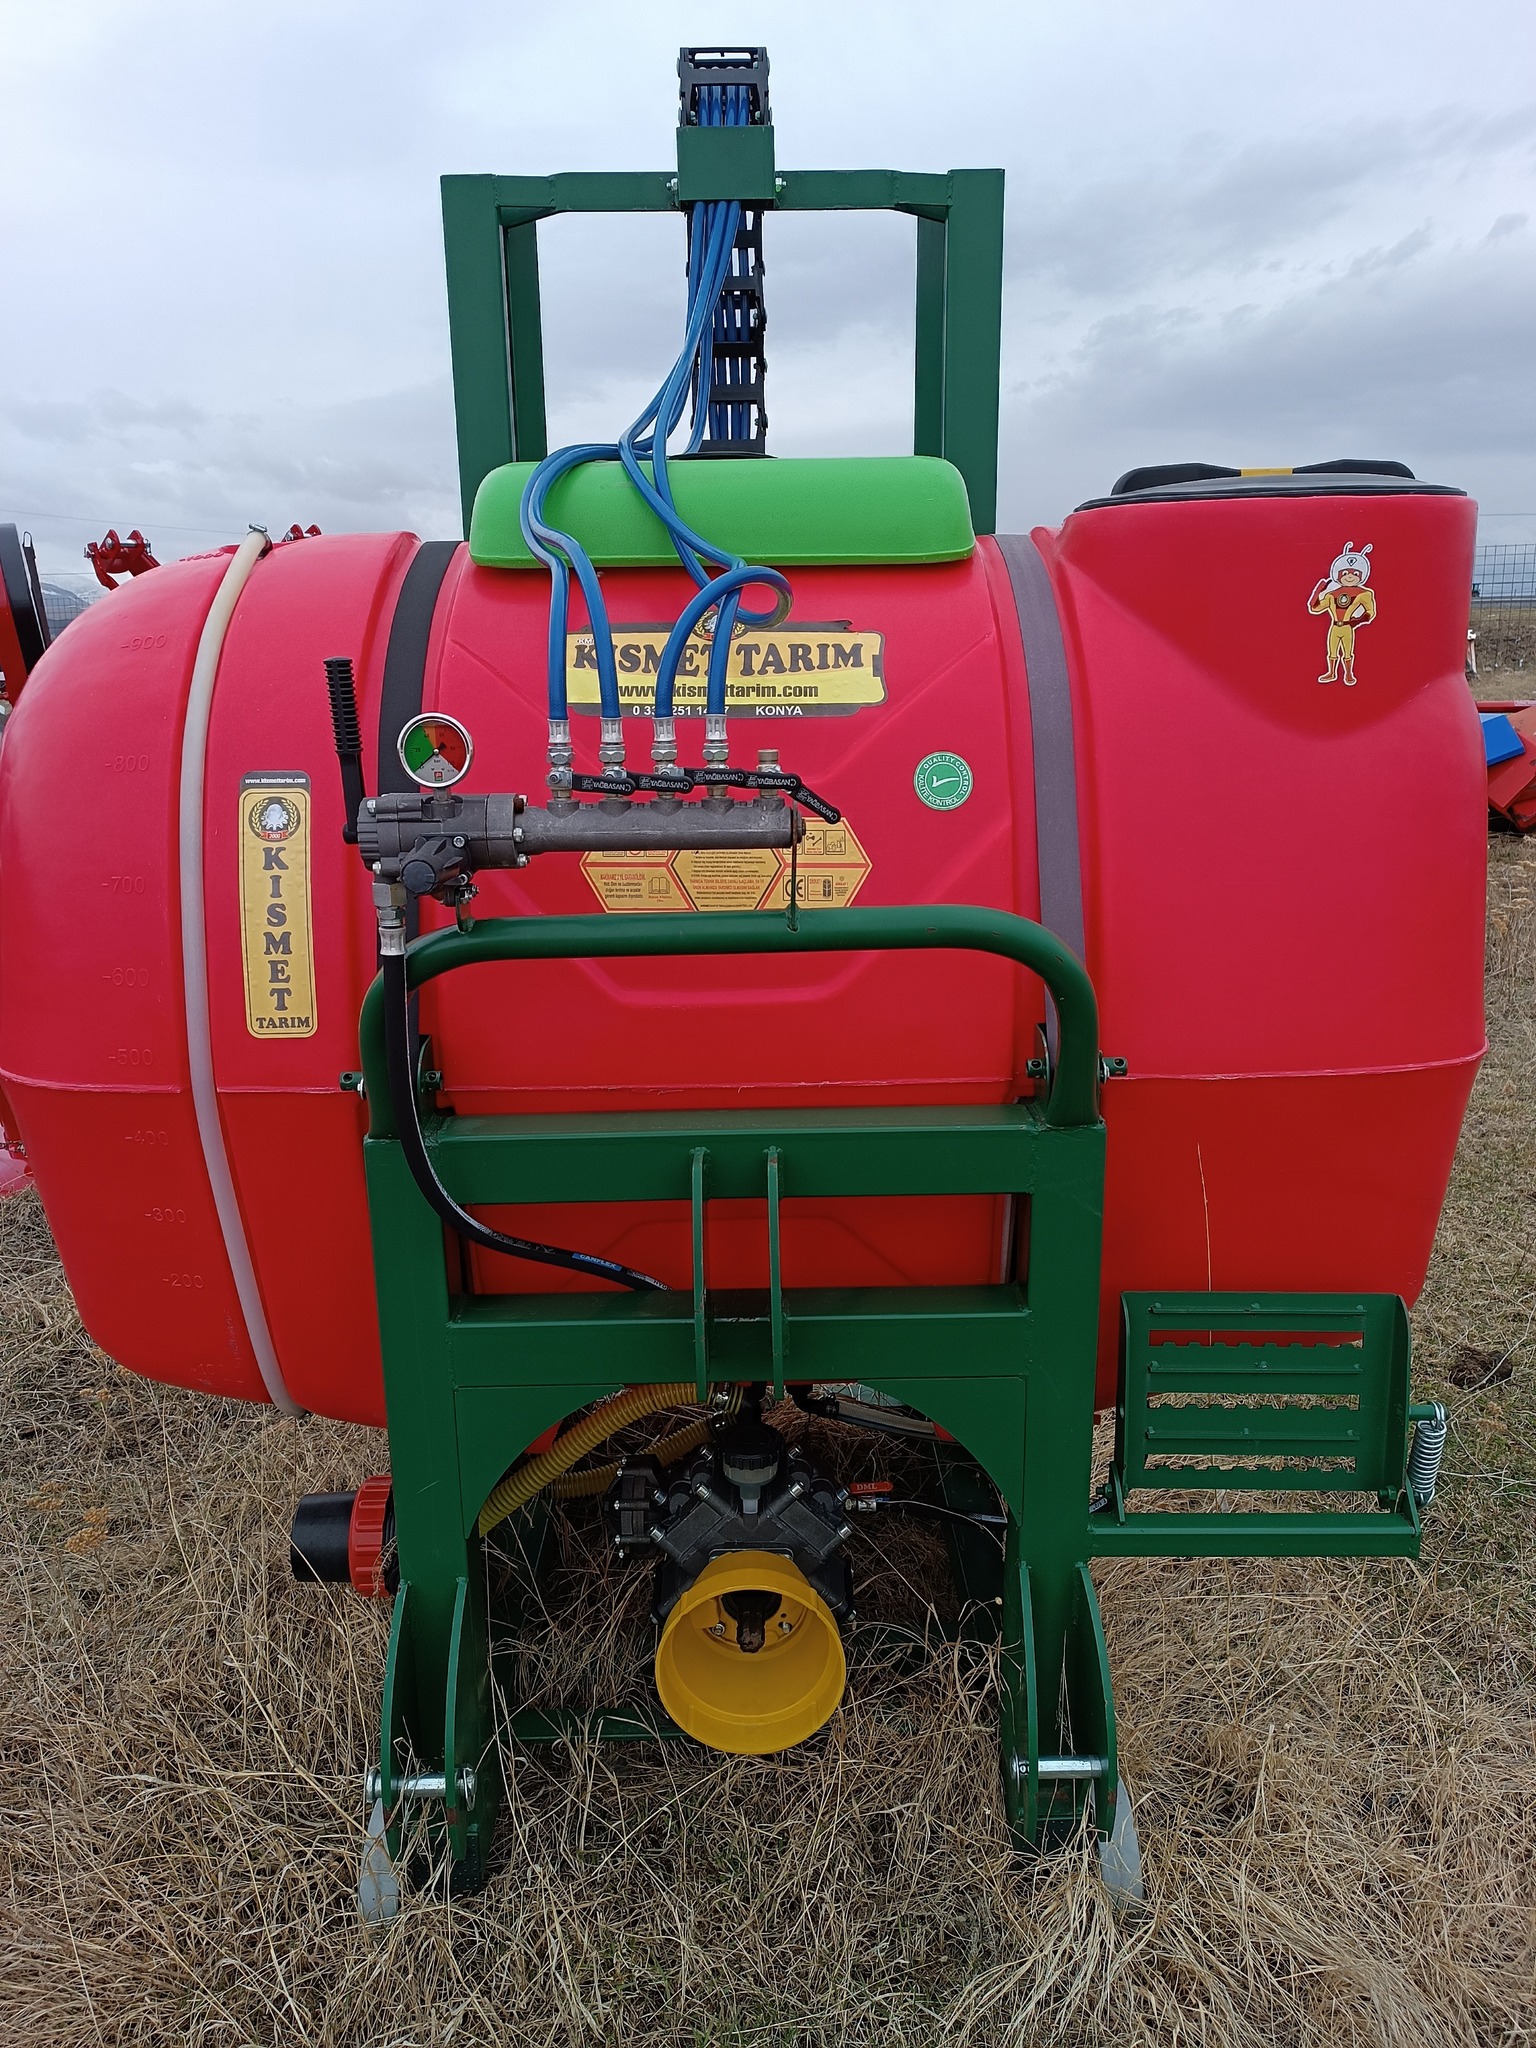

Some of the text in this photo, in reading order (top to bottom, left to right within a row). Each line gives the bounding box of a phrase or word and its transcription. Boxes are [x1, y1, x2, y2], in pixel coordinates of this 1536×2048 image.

[735, 643, 865, 677] TARIM
[672, 705, 692, 715] 251
[755, 705, 804, 716] KONYA
[923, 756, 969, 795] QUALITY CONTROL
[927, 796, 961, 806] KONTROL
[262, 846, 293, 1012] KISMET
[255, 1016, 311, 1030] TARIM
[856, 1482, 878, 1491] DML
